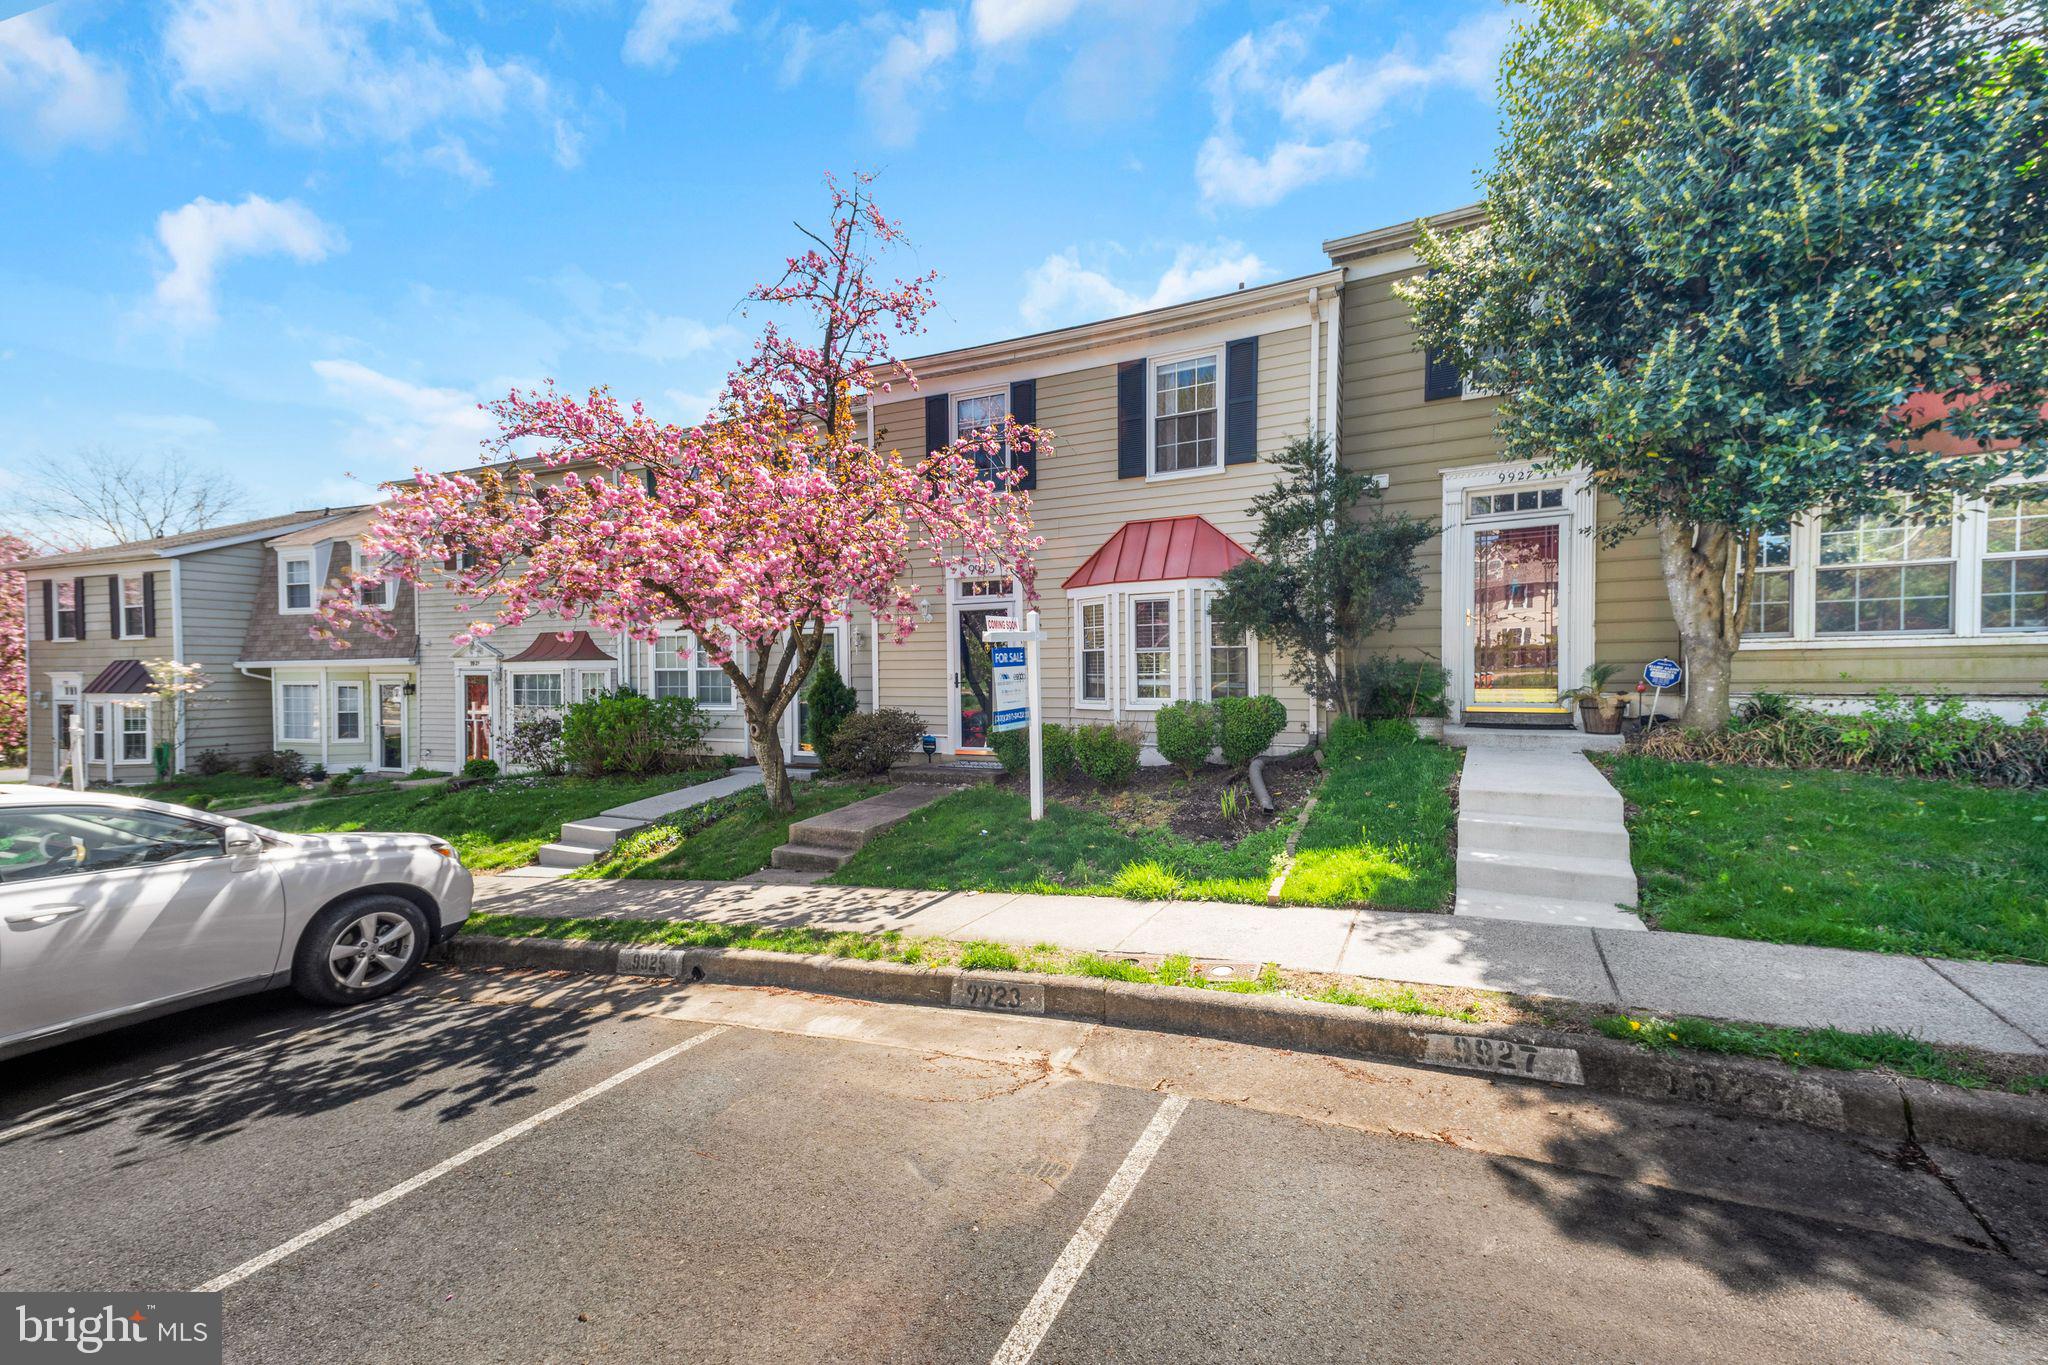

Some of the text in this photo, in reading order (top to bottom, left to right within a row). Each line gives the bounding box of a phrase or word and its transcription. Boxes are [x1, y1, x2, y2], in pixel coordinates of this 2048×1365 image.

[1498, 470, 1533, 484] 9927
[988, 619, 1006, 629] COMING
[994, 652, 1024, 663] FOR SALE
[631, 953, 666, 973] 9925
[966, 983, 1021, 1008] 9923
[1453, 1036, 1538, 1073] 9927
